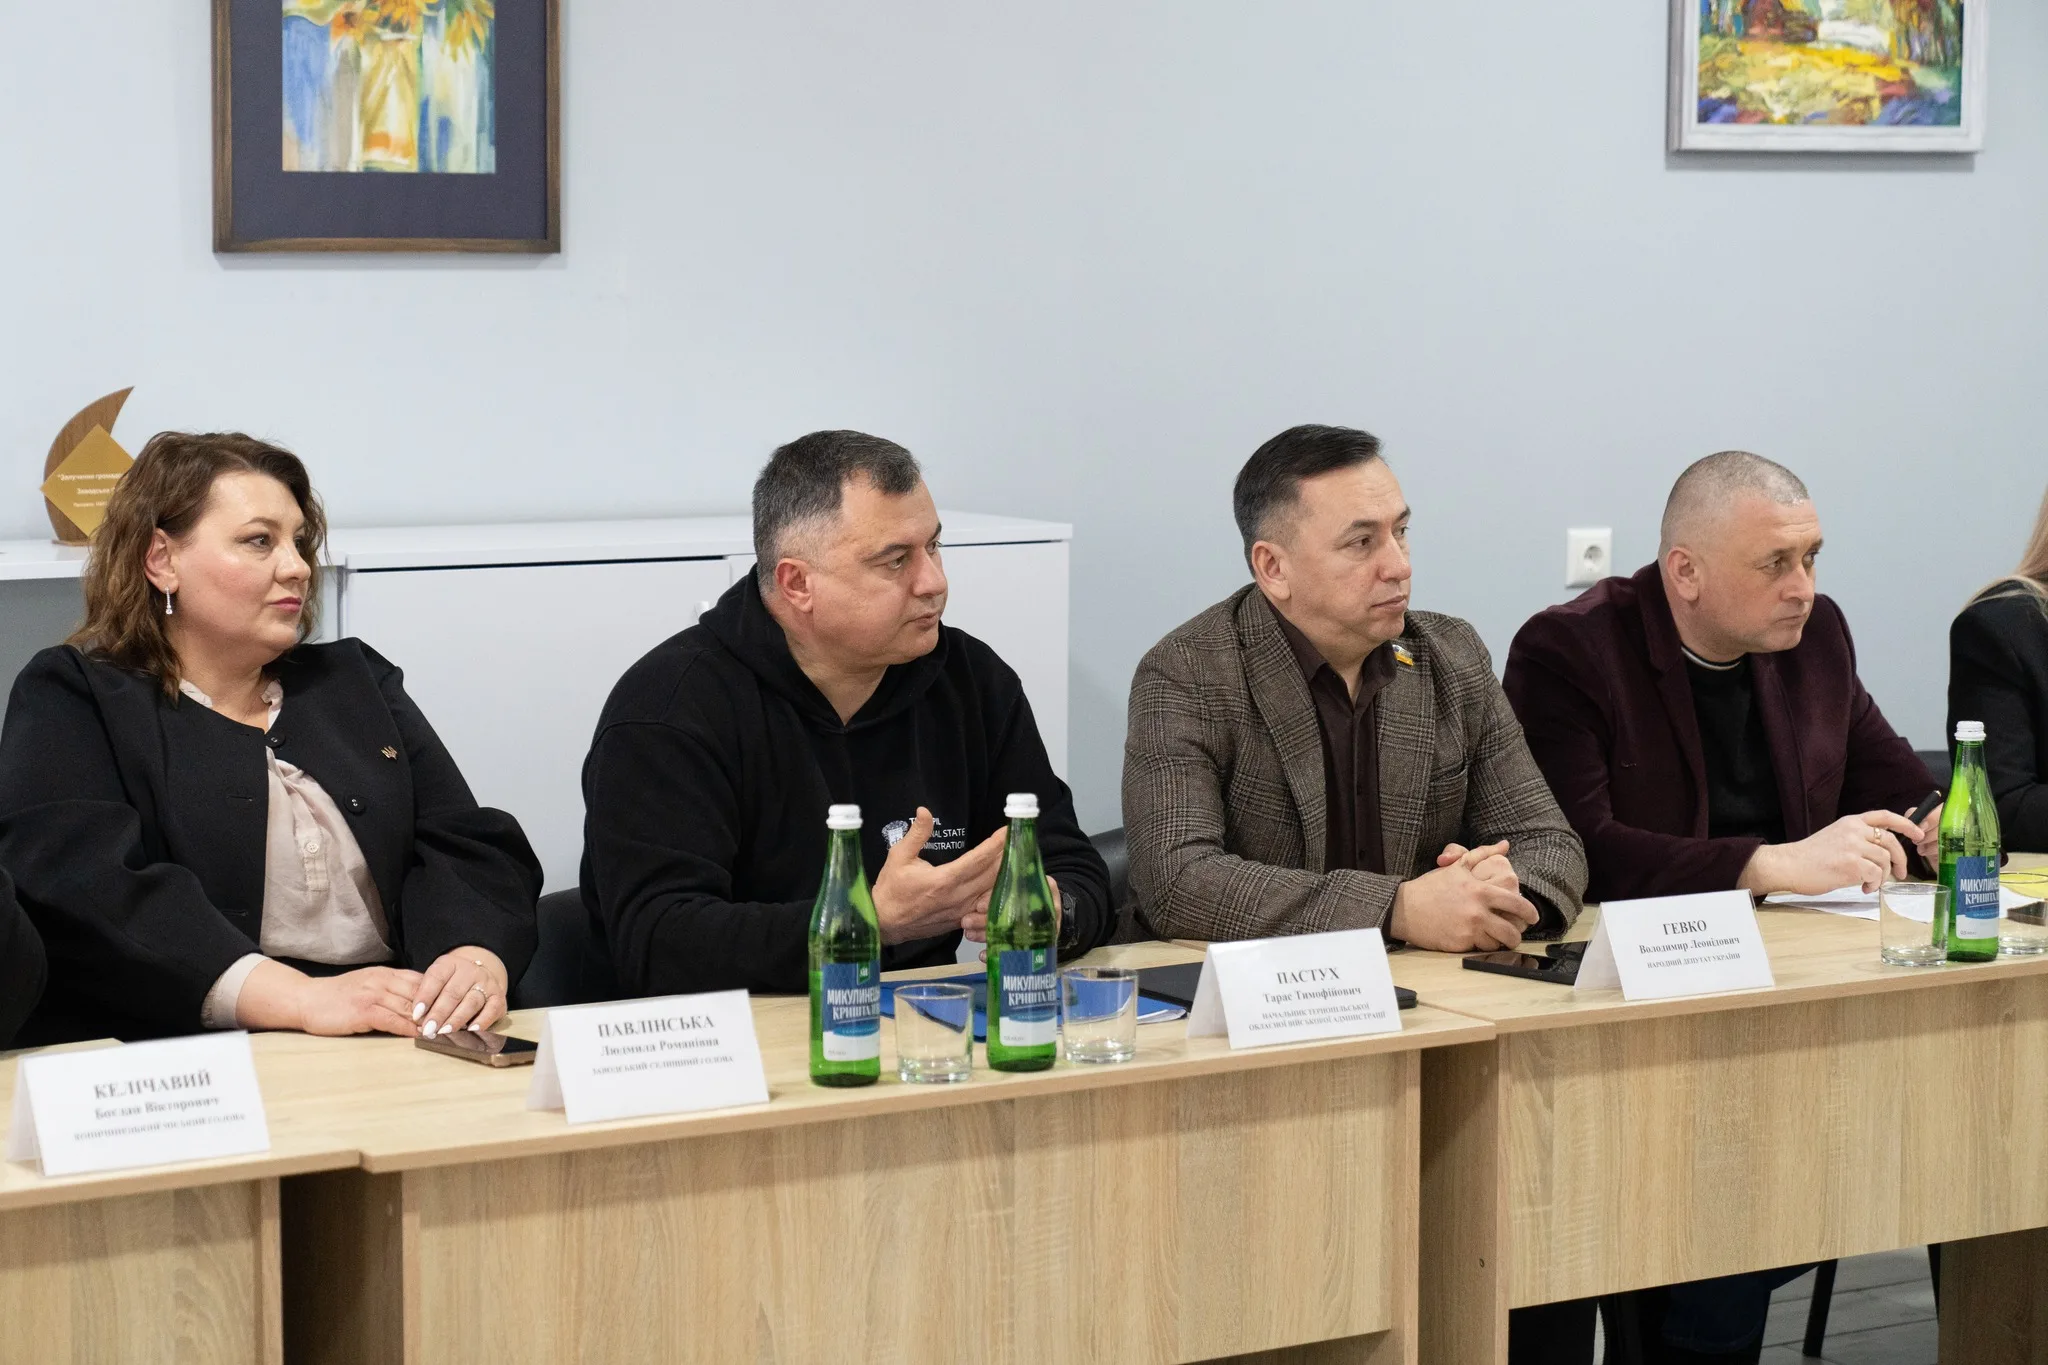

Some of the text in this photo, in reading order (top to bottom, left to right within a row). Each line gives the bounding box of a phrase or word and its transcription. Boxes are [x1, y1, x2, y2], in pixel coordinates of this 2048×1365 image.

[942, 827, 966, 838] STATE
[1662, 919, 1707, 935] ГЕВКО
[1639, 936, 1740, 954] Володимир Леонідович
[1647, 952, 1741, 969] НАРОДНИЙ ДЕПУТАТ УКРАЇНИ
[1276, 966, 1341, 985] ПАСТУХ
[1263, 986, 1362, 1005] Тарас Тимофійович
[1262, 1007, 1308, 1020] НАЧАЛЬНИК
[597, 1014, 715, 1038] ПАВЛІНСЬКА
[601, 1037, 720, 1056] Людмила Романівна
[93, 1068, 212, 1100] КЕЛІЧАВИЙ
[94, 1096, 219, 1120] Богдан Вікторович
